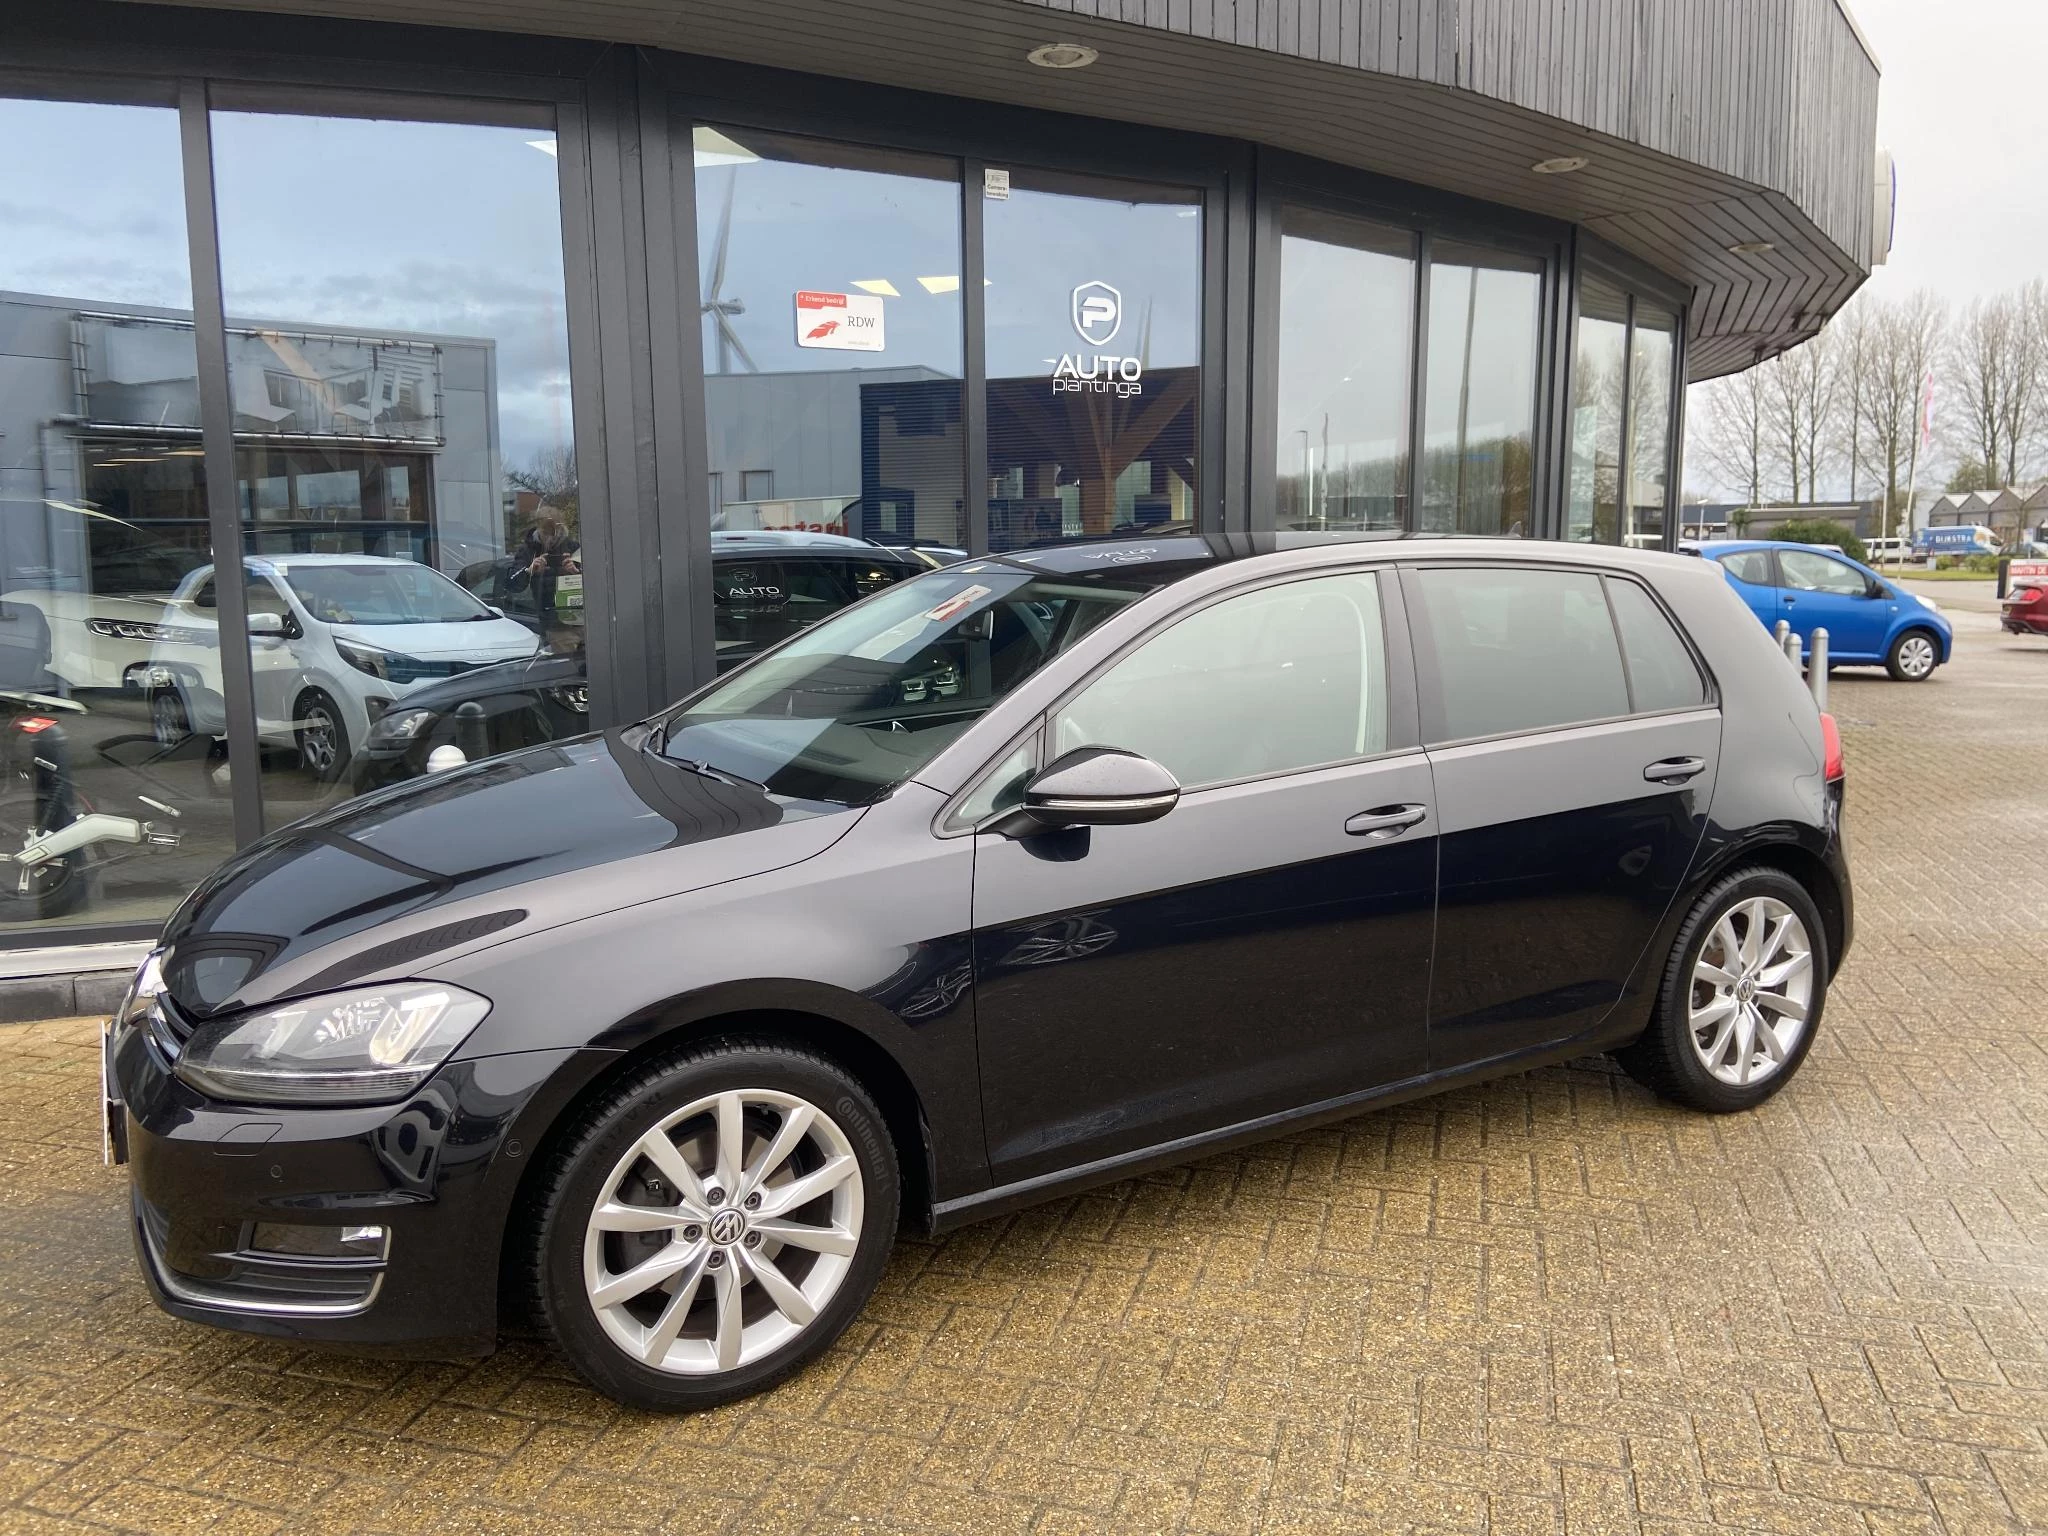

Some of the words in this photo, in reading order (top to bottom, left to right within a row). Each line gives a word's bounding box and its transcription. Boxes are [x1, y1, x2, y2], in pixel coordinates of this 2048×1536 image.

[847, 315, 875, 328] RDW
[1053, 353, 1142, 381] AUTO
[1053, 377, 1142, 399] plantinga
[2010, 565, 2036, 575] MARTIN
[729, 586, 780, 596] AUTO
[836, 1096, 889, 1181] Continental
